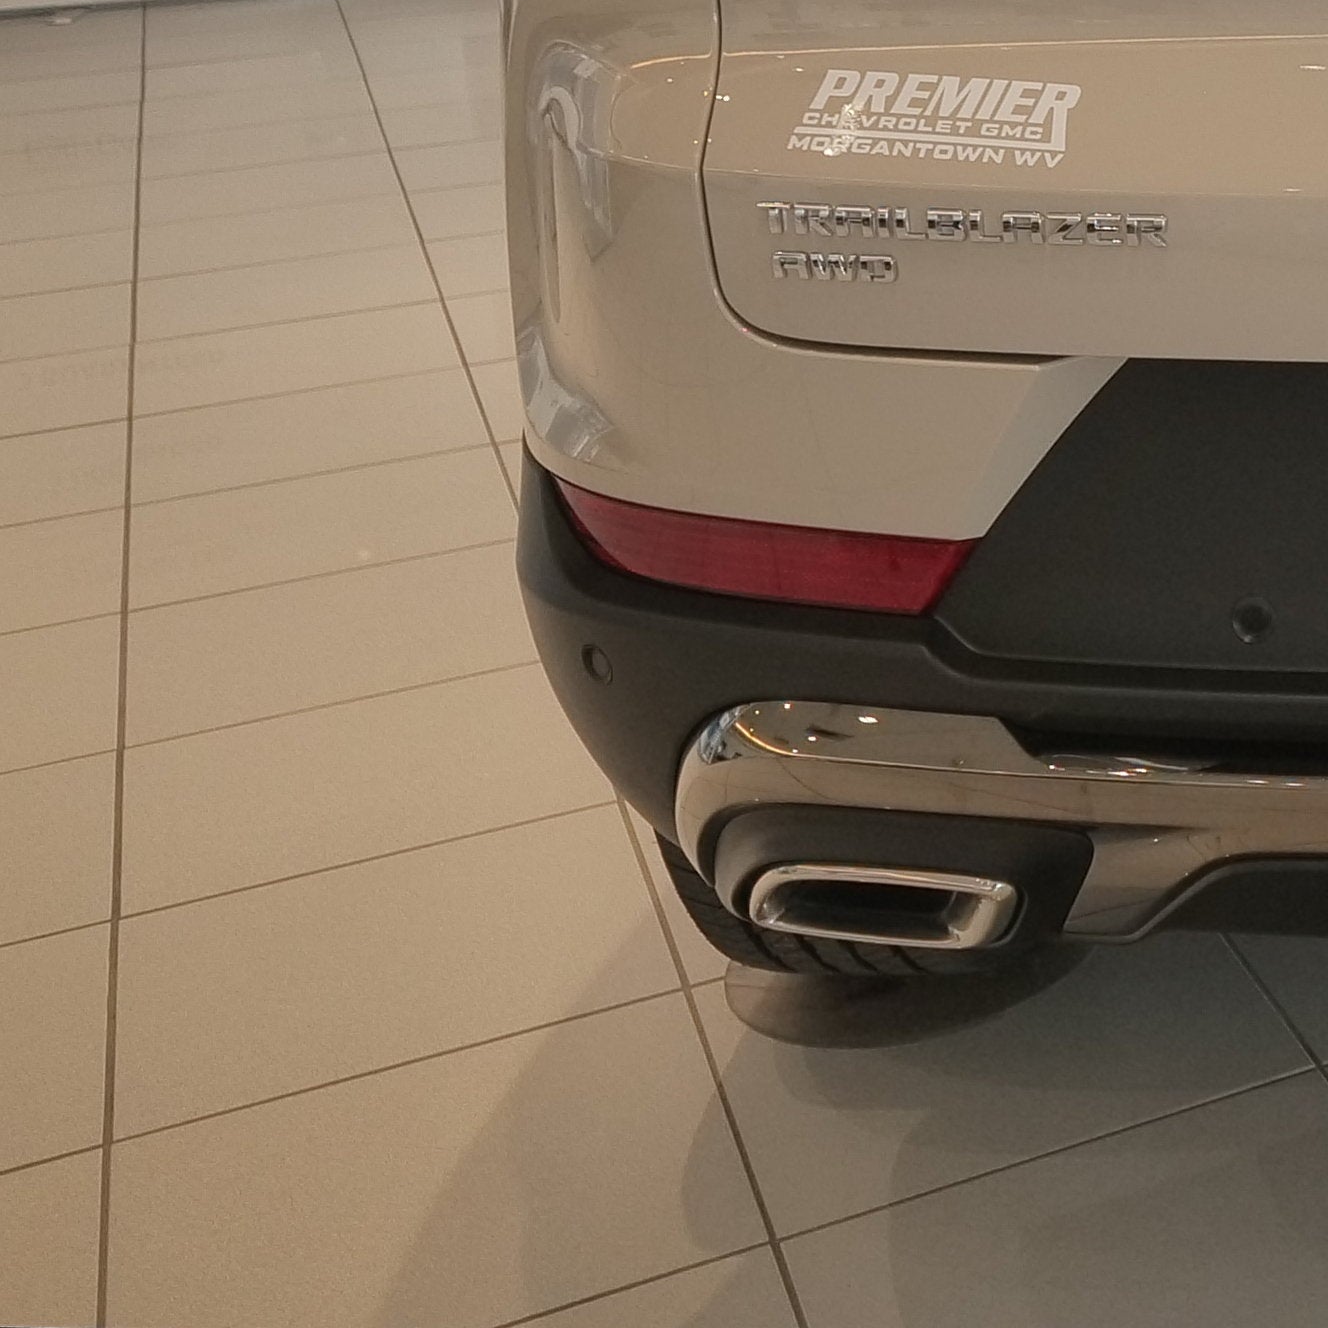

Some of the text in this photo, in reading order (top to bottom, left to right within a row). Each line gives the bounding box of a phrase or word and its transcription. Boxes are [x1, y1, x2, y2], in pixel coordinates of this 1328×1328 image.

[809, 69, 1081, 130] PREMIER
[802, 112, 1045, 140] CHEVROLET GMC
[787, 135, 1065, 168] MORGANTOWN WV
[755, 200, 1169, 248] TRAILBLAZER
[771, 251, 898, 283] AWD
